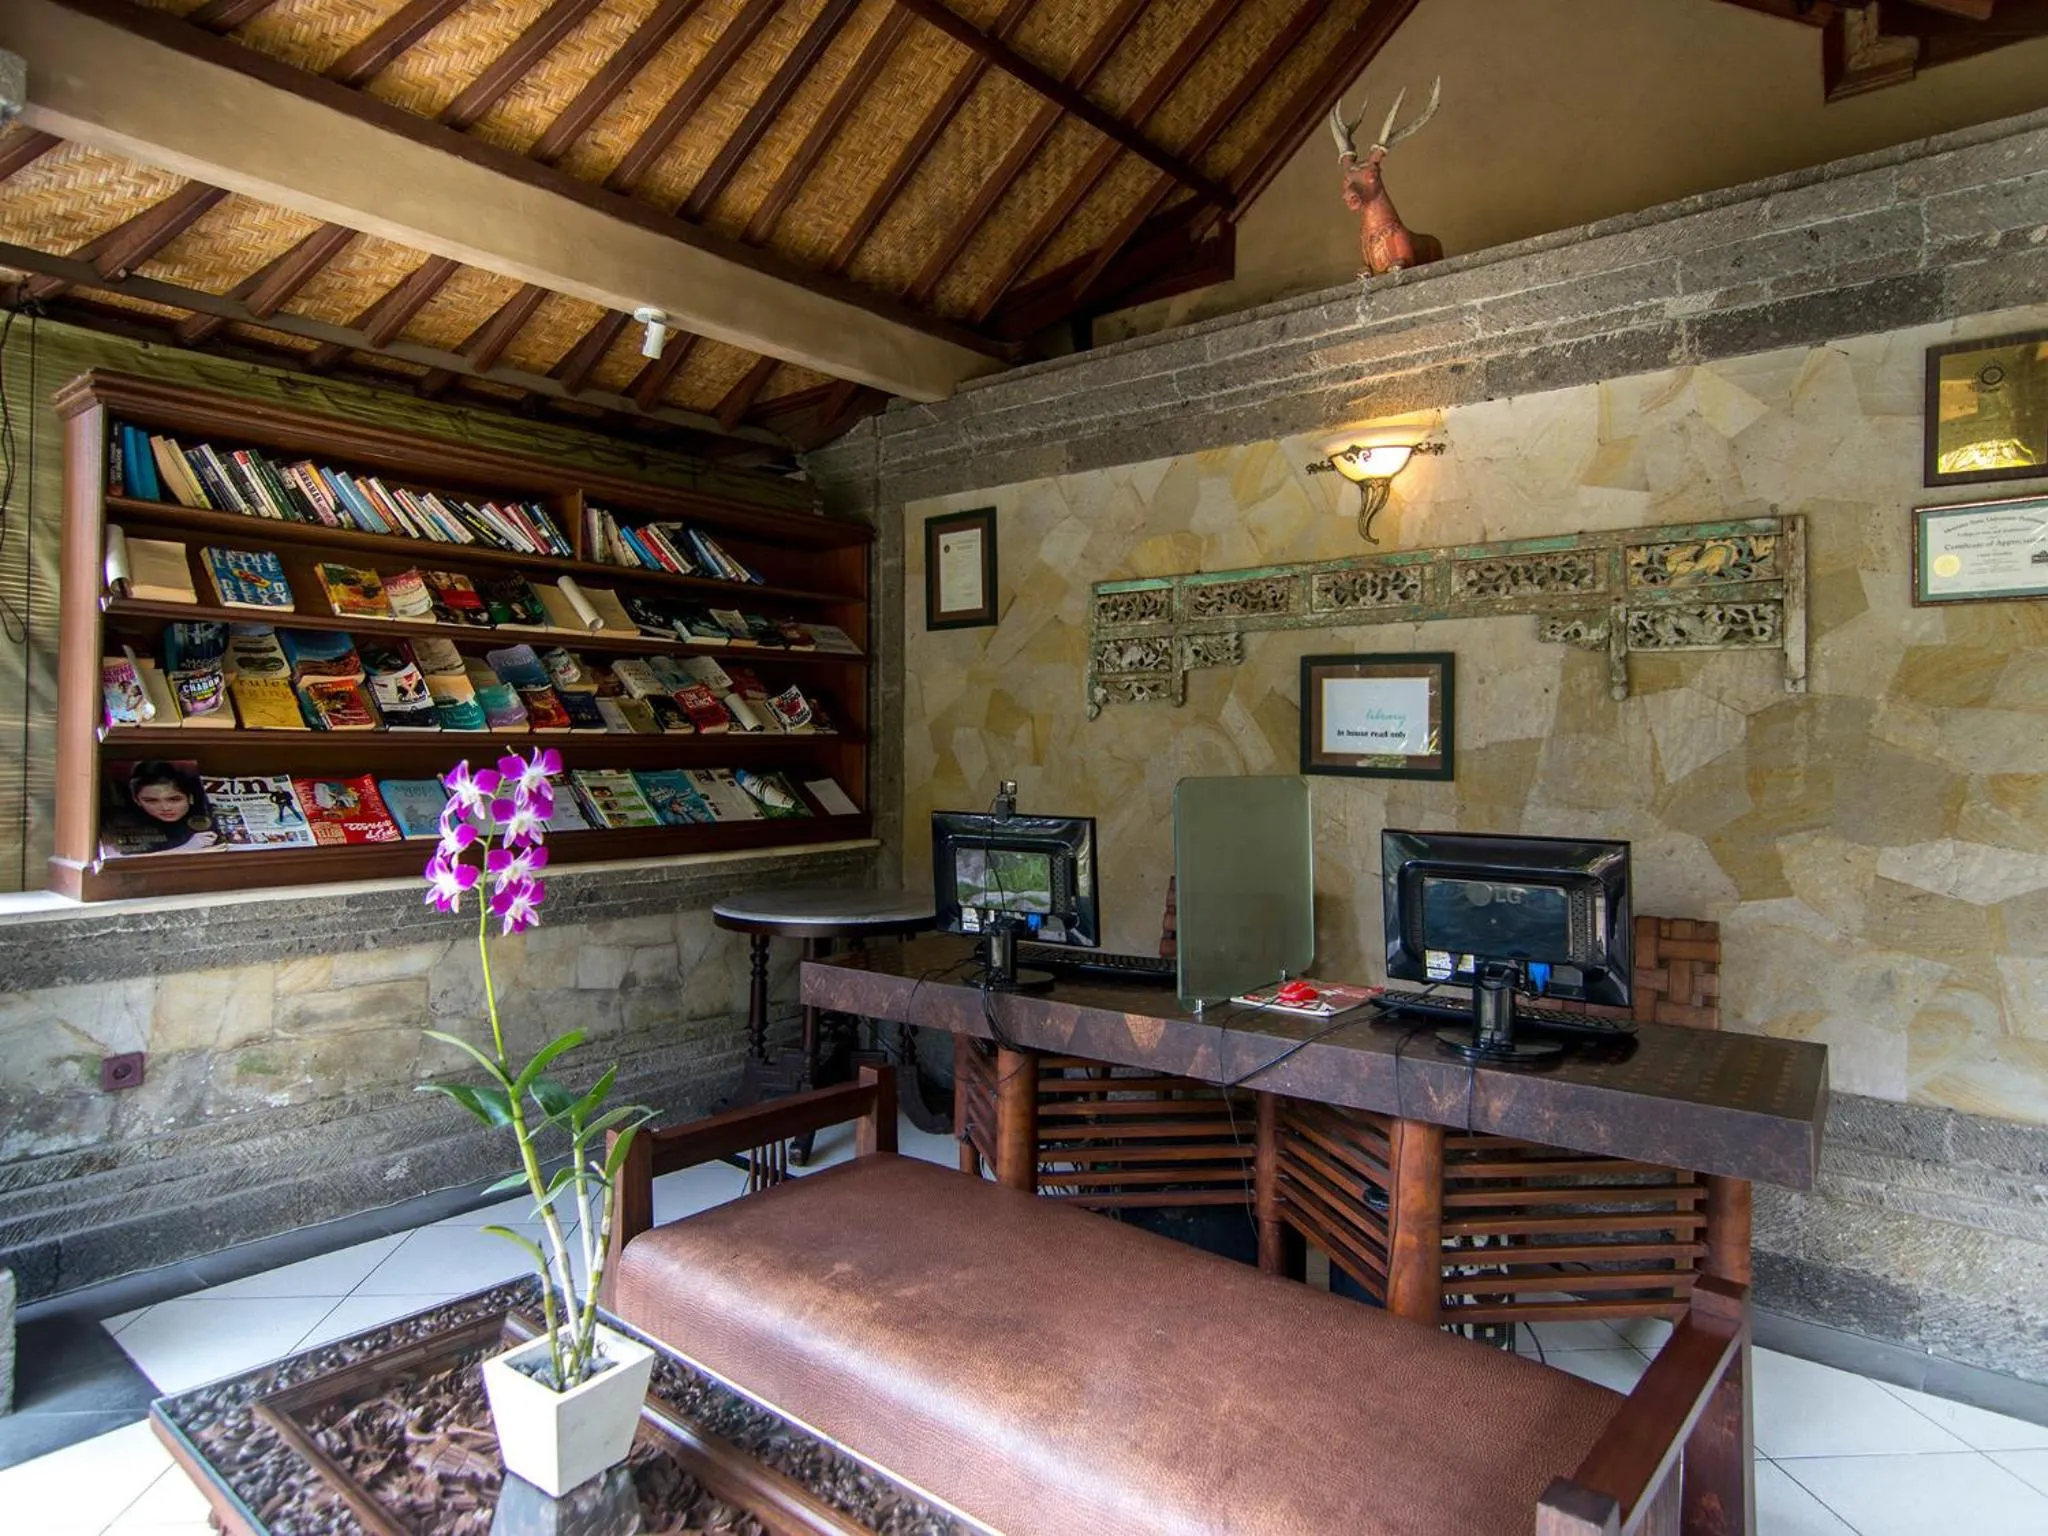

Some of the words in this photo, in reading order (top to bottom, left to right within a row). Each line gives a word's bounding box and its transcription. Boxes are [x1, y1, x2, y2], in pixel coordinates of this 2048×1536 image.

[1371, 729, 1388, 738] read
[1390, 730, 1406, 739] only
[1495, 886, 1522, 905] LG
